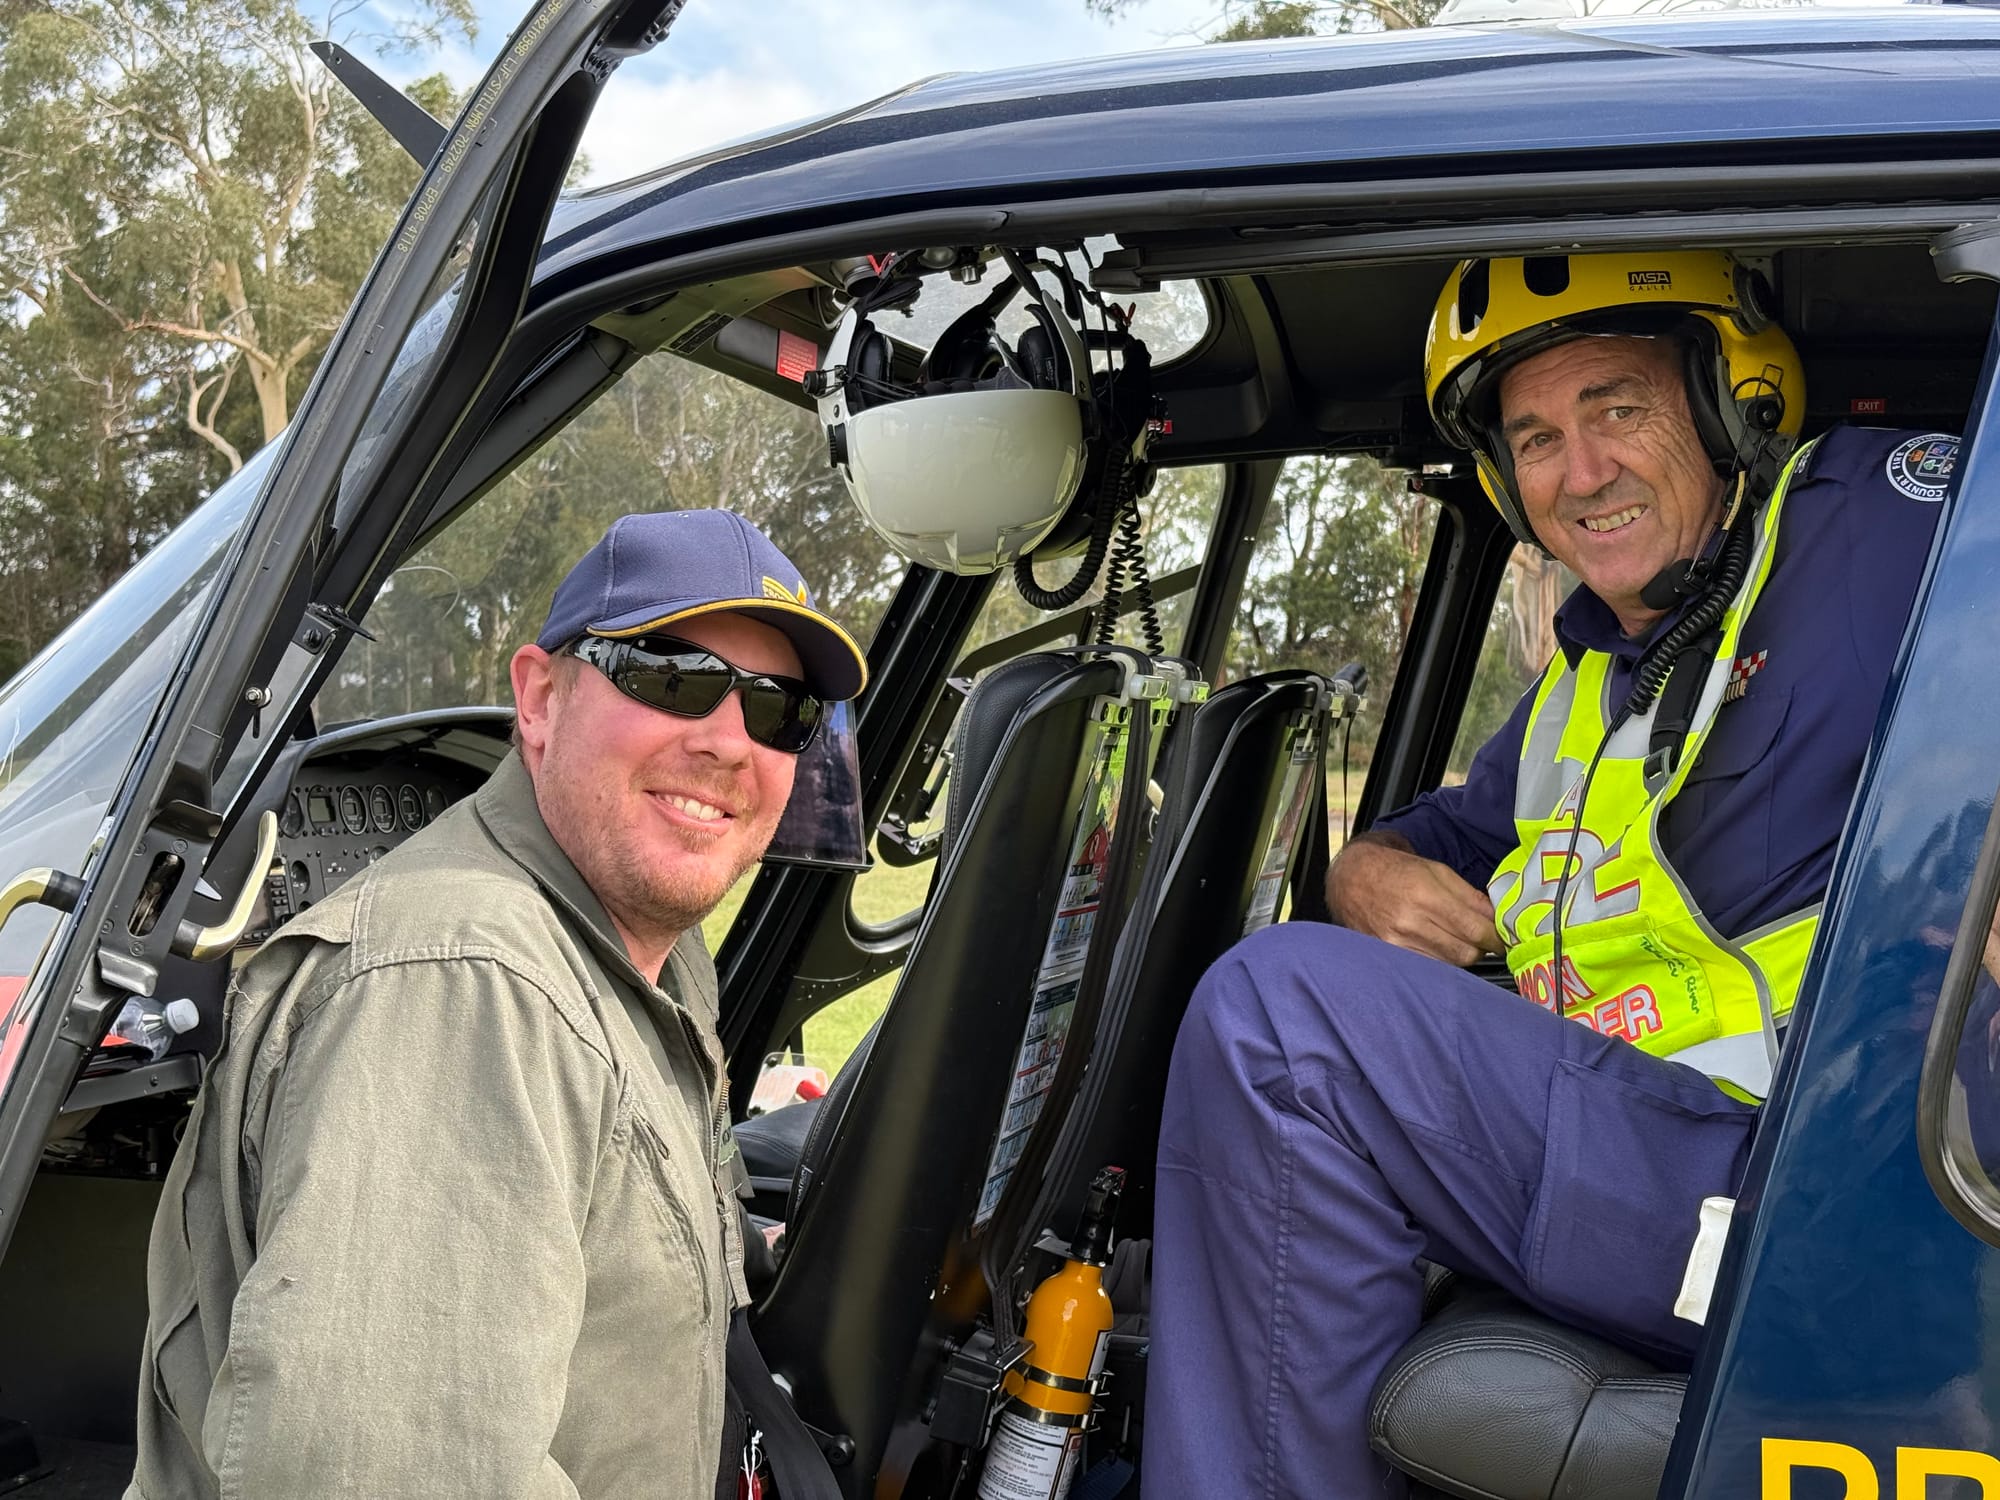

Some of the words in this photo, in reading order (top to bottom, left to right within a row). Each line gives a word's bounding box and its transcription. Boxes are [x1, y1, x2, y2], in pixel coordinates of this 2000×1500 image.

[465, 55, 519, 132] LJF/STILLMAN
[440, 132, 469, 175] 702749
[413, 186, 439, 222] EP708
[1630, 272, 1670, 284] MSA
[1857, 401, 1880, 411] EXIT
[1891, 451, 1904, 469] FIRE
[1895, 474, 1943, 497] COUNTRY
